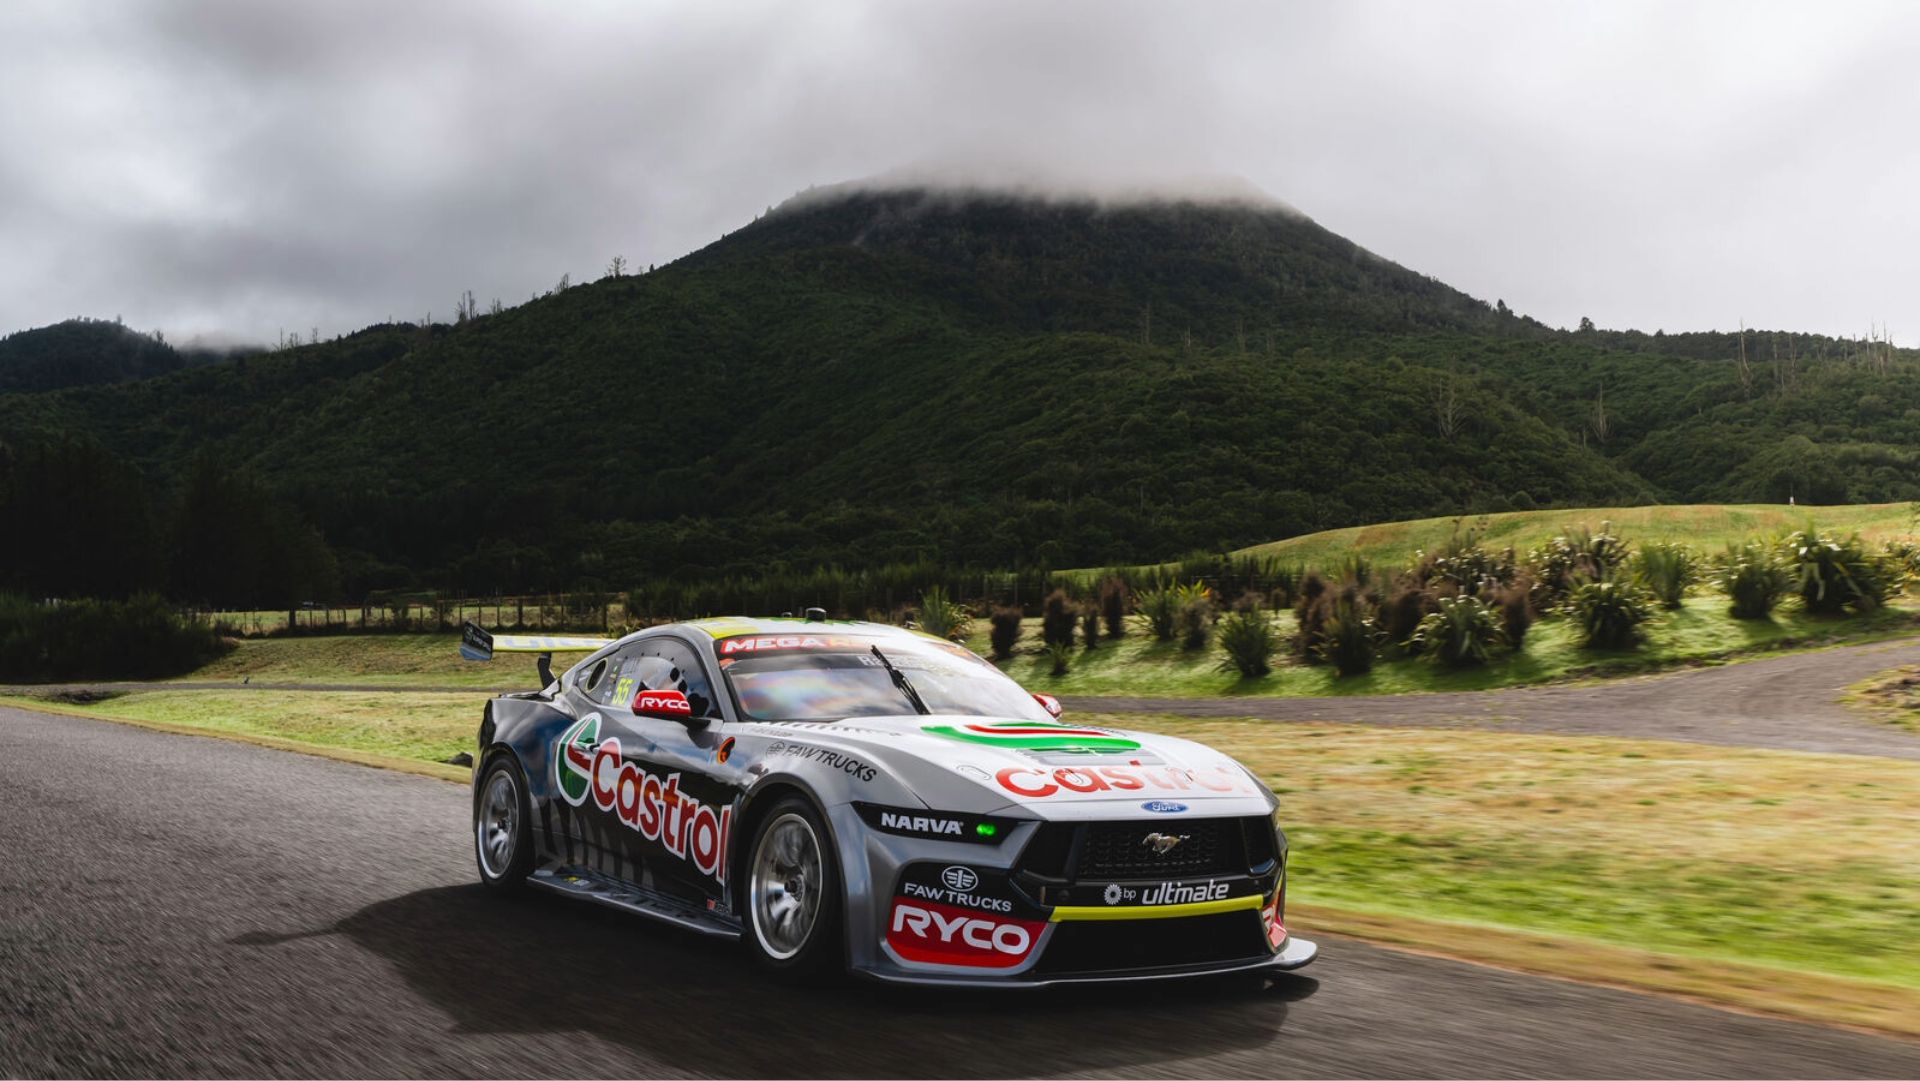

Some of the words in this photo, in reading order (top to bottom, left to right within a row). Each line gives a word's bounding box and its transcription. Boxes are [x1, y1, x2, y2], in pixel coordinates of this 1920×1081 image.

[722, 637, 827, 653] MEGA
[612, 677, 635, 705] 55
[782, 745, 819, 760] FAW
[814, 750, 877, 782] TRUCKS
[592, 737, 732, 886] Castrol
[881, 813, 963, 835] NARVA
[904, 882, 944, 901] FAW
[945, 890, 1013, 912] TRUCKS
[1123, 888, 1137, 901] bp
[1141, 879, 1230, 905] ultimate
[893, 904, 1030, 955] RYCO
